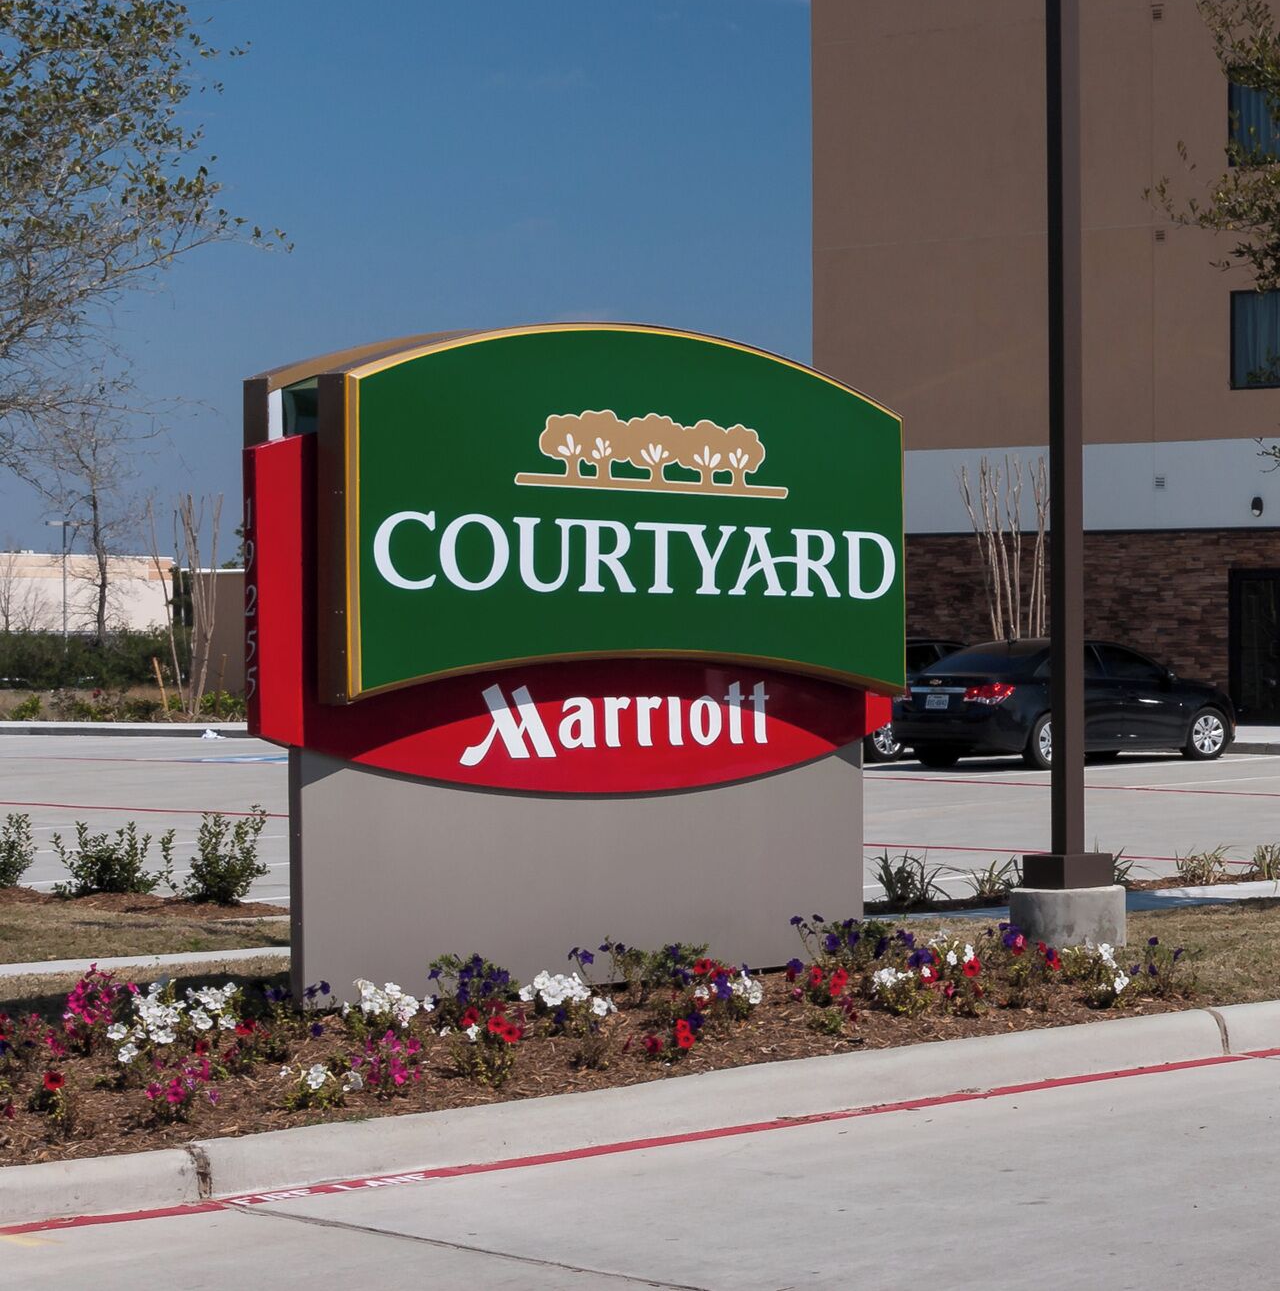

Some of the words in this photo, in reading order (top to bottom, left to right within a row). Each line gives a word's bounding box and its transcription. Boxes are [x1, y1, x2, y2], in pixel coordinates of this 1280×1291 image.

[244, 497, 258, 700] 19255
[373, 510, 897, 600] COURTYARD
[459, 680, 770, 767] Marriott
[229, 1188, 325, 1206] FIRE
[332, 1173, 438, 1192] LANE
